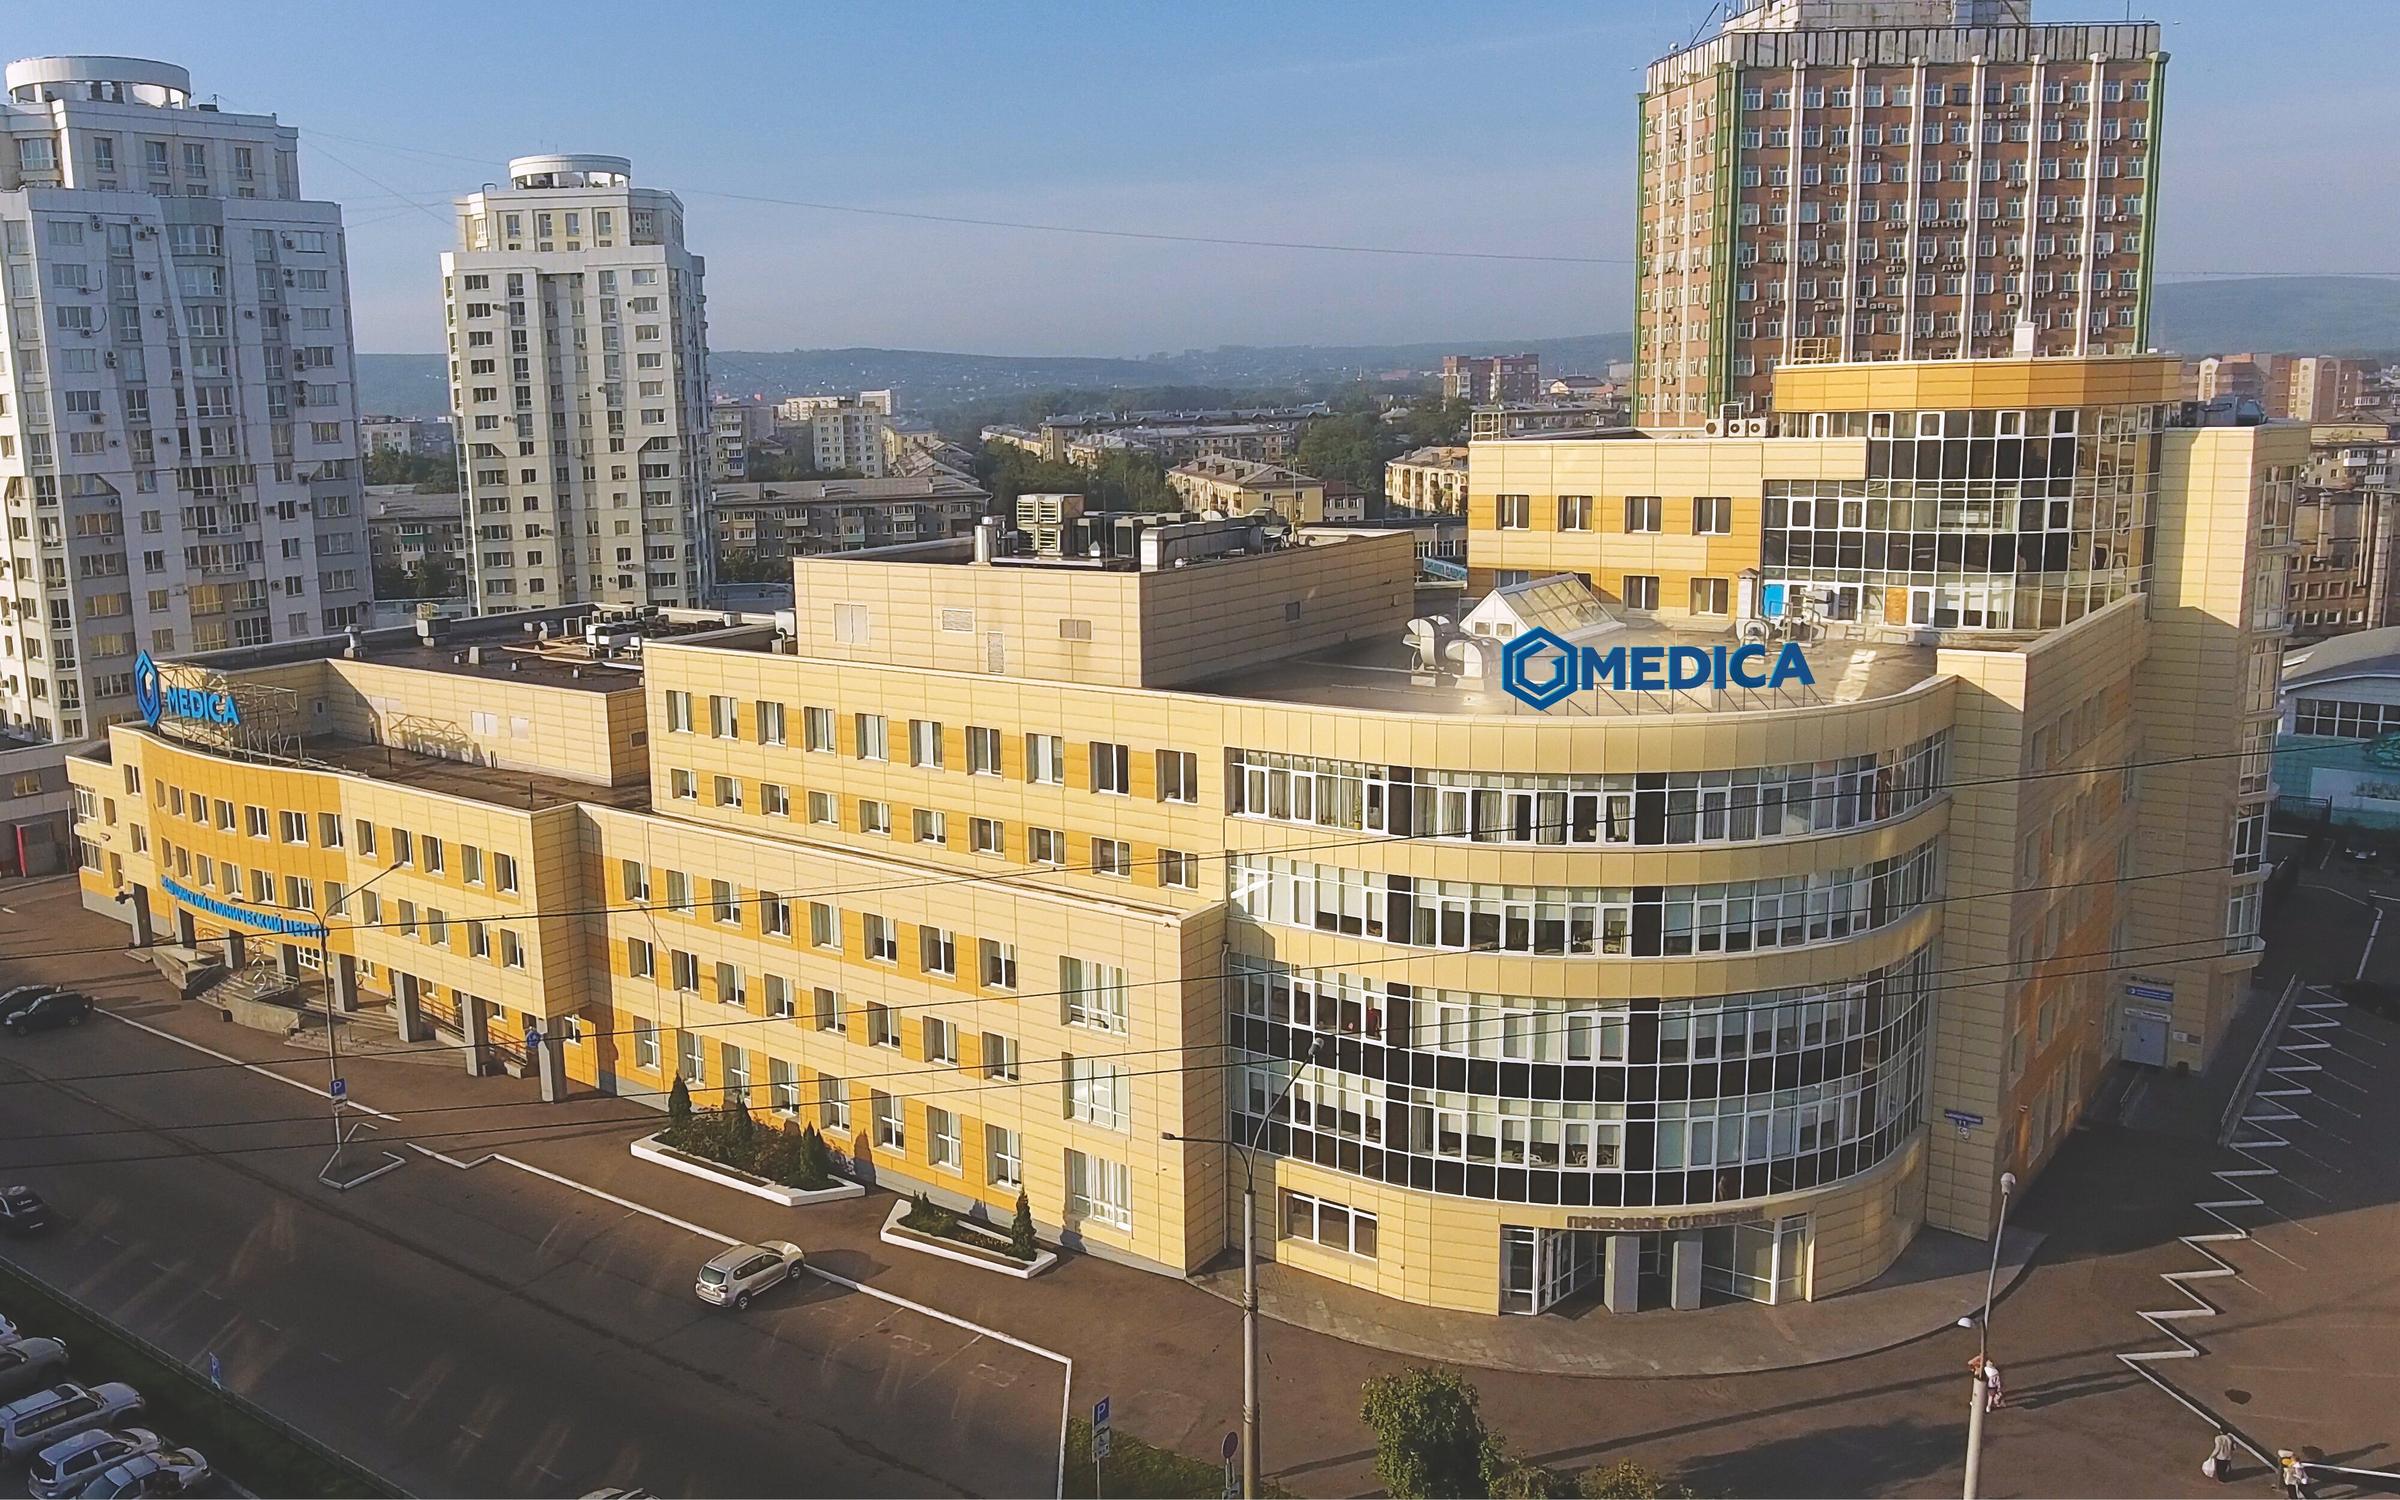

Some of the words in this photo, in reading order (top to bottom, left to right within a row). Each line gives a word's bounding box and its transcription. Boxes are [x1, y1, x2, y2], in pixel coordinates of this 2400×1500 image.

[1581, 642, 1815, 690] MEDICA
[167, 686, 239, 725] MEDICA
[205, 899, 281, 931] КЛИНИЧЕСКИЙ
[1097, 1402, 1106, 1422] P
